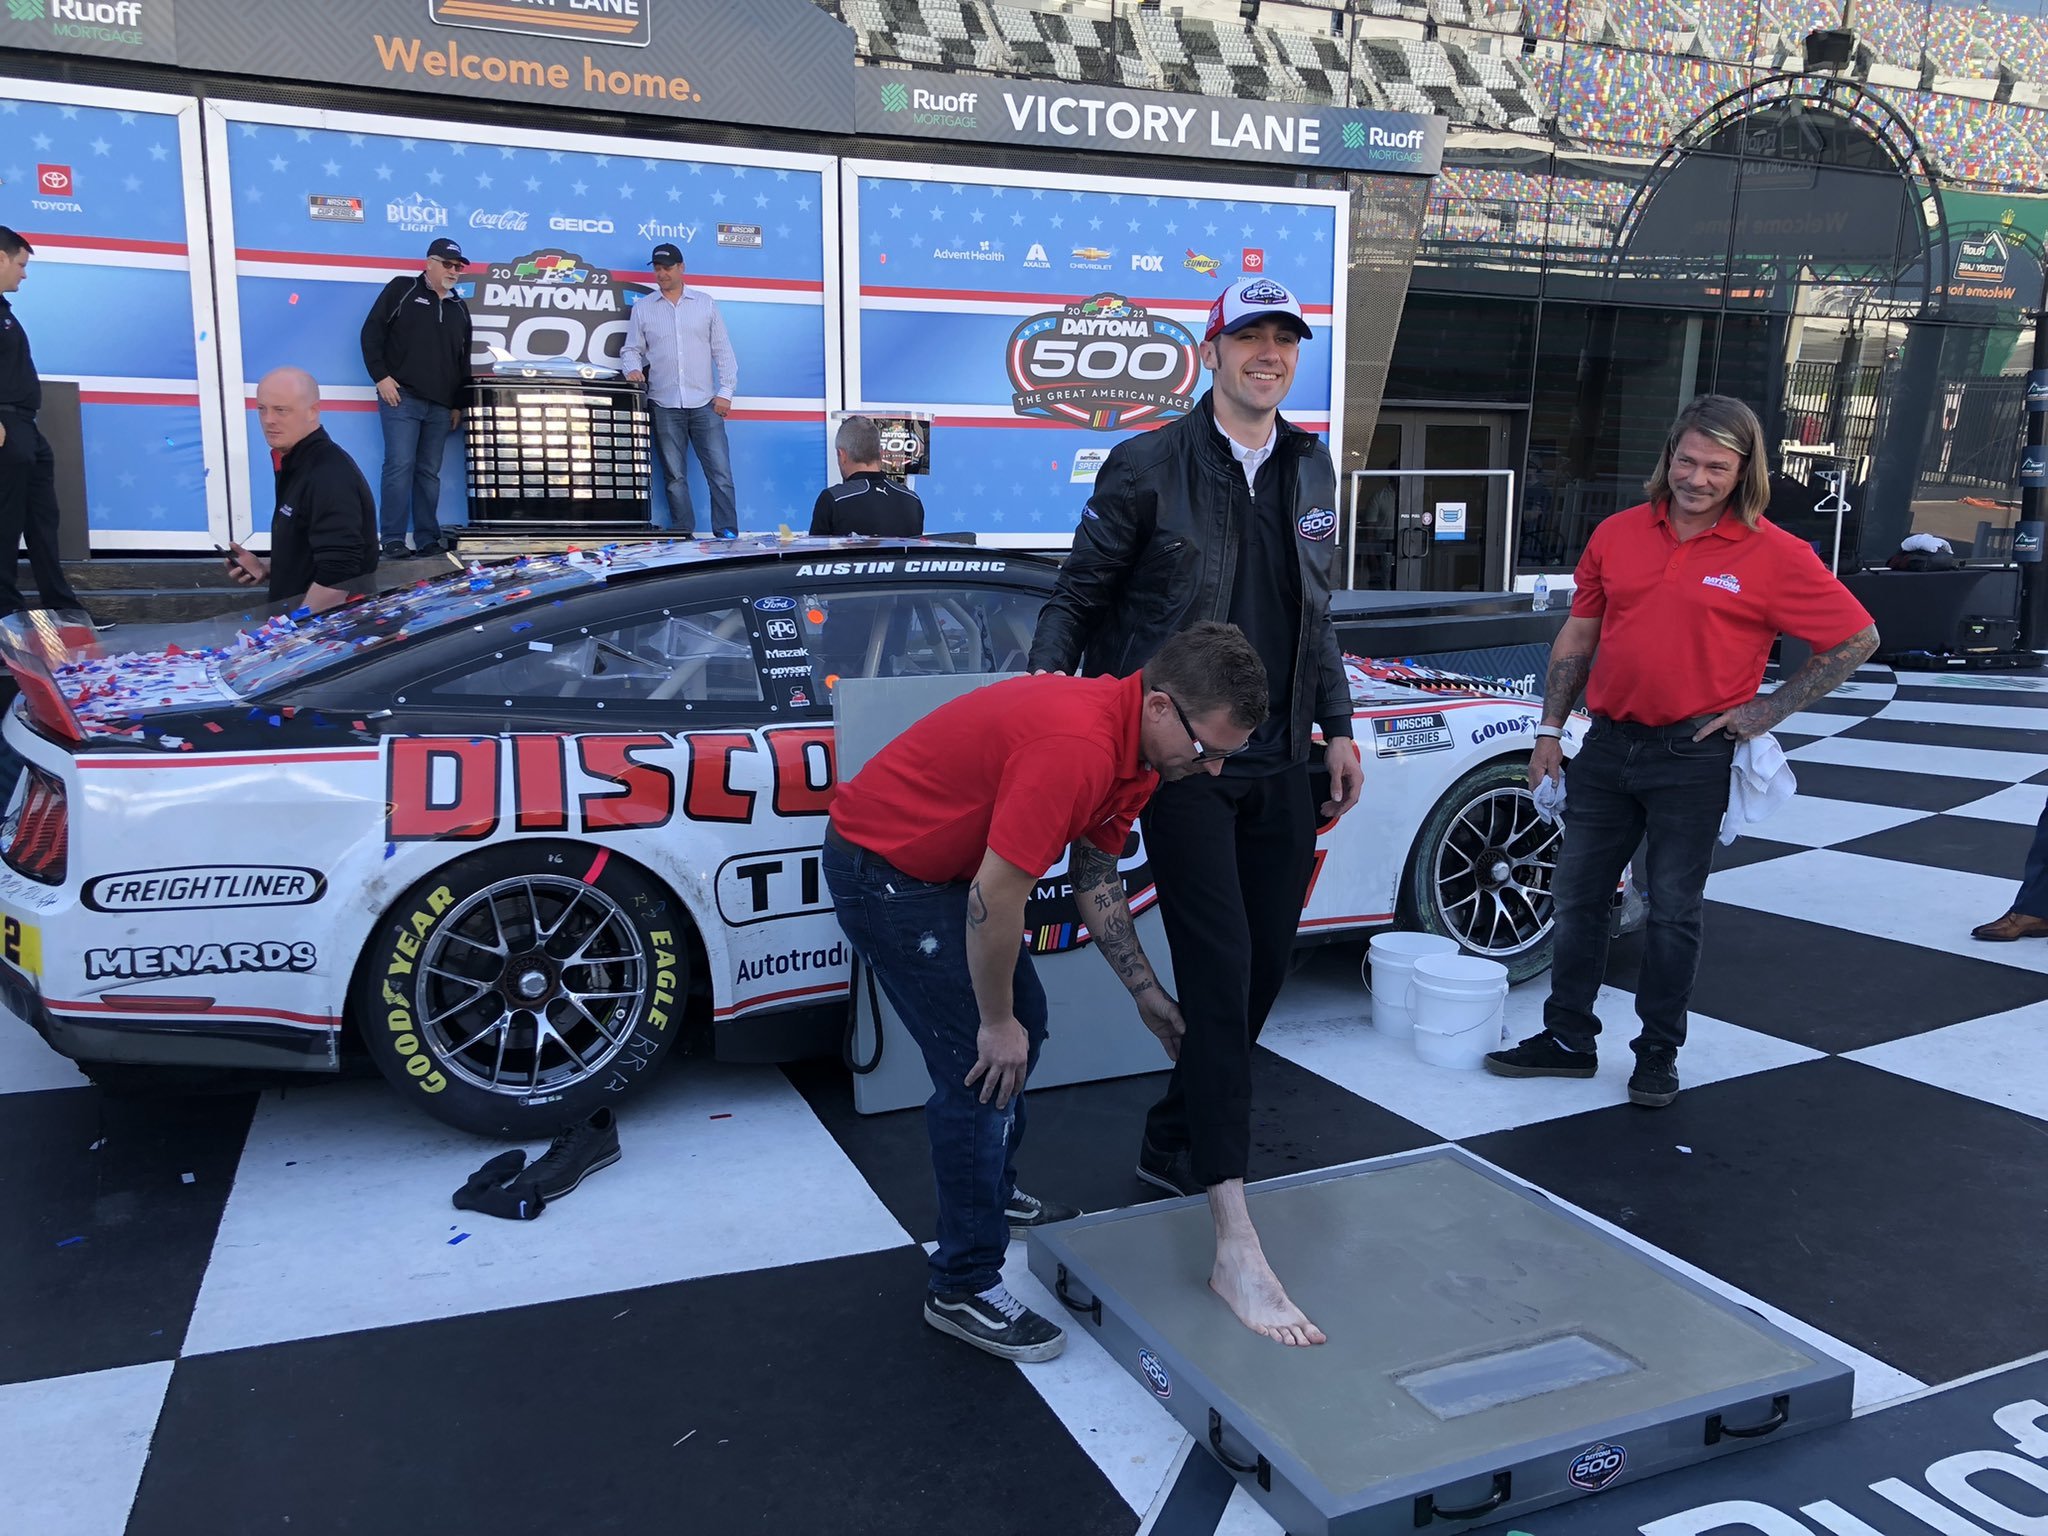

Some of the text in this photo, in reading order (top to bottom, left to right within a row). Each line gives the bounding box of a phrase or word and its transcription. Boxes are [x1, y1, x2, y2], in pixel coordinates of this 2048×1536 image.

[52, 0, 142, 26] Ruoff
[54, 24, 143, 45] MORTGAGE
[373, 34, 701, 103] Welcome home.
[914, 88, 978, 113] Ruoff
[914, 113, 977, 128] MORTGAGE
[1003, 93, 1320, 154] VICTORY LANE
[1368, 127, 1424, 149] Ruoff
[1368, 149, 1422, 163] MORTGAGE
[31, 200, 83, 213] TOYOTA
[387, 204, 448, 227] BUSCH
[400, 223, 436, 233] LIGHT
[550, 217, 614, 234] GEICO
[638, 219, 697, 243] xfinity
[1070, 263, 1112, 271] CHEVROLET
[1131, 254, 1164, 272] FOX
[1185, 259, 1219, 268] SUNOCO
[492, 269, 608, 285] 20 22
[484, 284, 616, 312] DAYTONA
[1068, 307, 1144, 318] 20 22
[1061, 318, 1149, 338] DAYTONA
[1030, 339, 1178, 380] 500
[1018, 389, 1190, 410] THE GREAT AMERICAN RACE
[1302, 515, 1334, 532] 500
[796, 560, 1006, 577] AUSTIN CINDRIC
[1702, 576, 1741, 592] DAYTONA
[762, 598, 789, 609] Ford
[769, 621, 795, 638] PPG
[765, 647, 810, 659] Mazak
[770, 665, 812, 675] ODYSSEY
[1397, 716, 1434, 731] NASCAR
[1386, 732, 1440, 748] CUP SERIES
[105, 875, 306, 903] FREIGHTLINER
[736, 857, 819, 912] TI
[4, 914, 21, 967] 2
[85, 941, 318, 980] MENARDS
[736, 941, 848, 985] Autotrad
[382, 885, 456, 1094] GOODYEAR
[647, 930, 677, 1031] EAGLE
[1142, 1356, 1167, 1388] 500
[1575, 1454, 1620, 1477] 500
